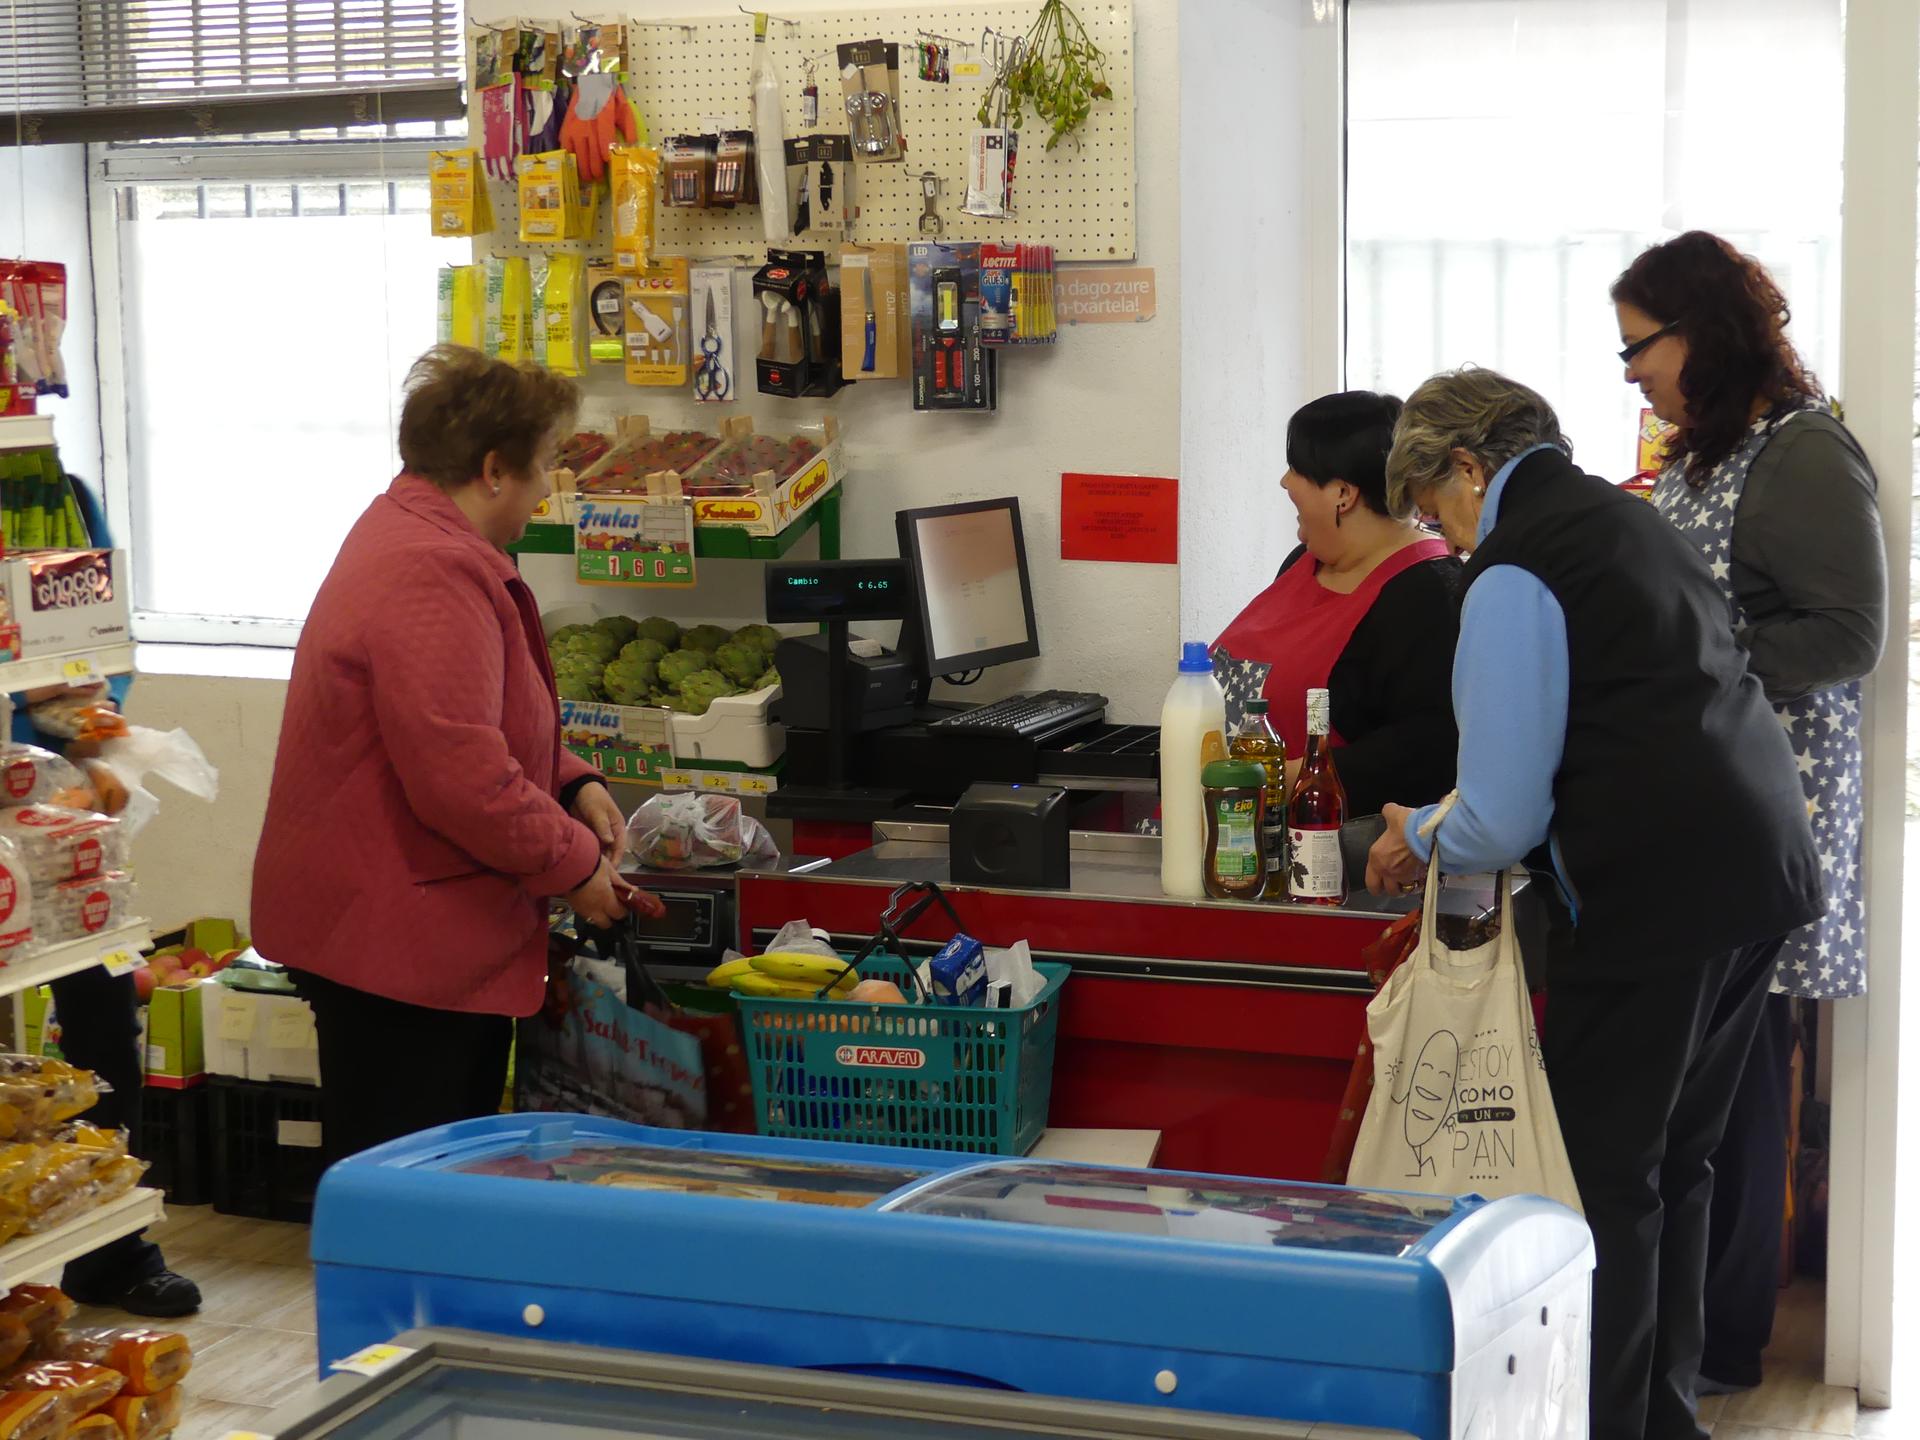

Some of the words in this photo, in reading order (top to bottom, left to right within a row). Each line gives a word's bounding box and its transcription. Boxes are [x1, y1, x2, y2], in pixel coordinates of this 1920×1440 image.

[913, 246, 928, 256] LED
[982, 257, 1018, 268] LOCTITE
[1068, 280, 1111, 299] dago
[1114, 280, 1150, 294] zure
[578, 503, 641, 530] Frutas
[37, 568, 98, 606] choco
[788, 577, 819, 586] Cambio
[868, 581, 888, 589] 6.65
[561, 702, 620, 729] Frutas
[858, 1050, 917, 1065] ARAVEN
[1458, 1045, 1514, 1081] ESTOY
[1459, 1085, 1514, 1103] COMO
[1473, 1108, 1492, 1120] UN
[1452, 1128, 1515, 1168] PAN
